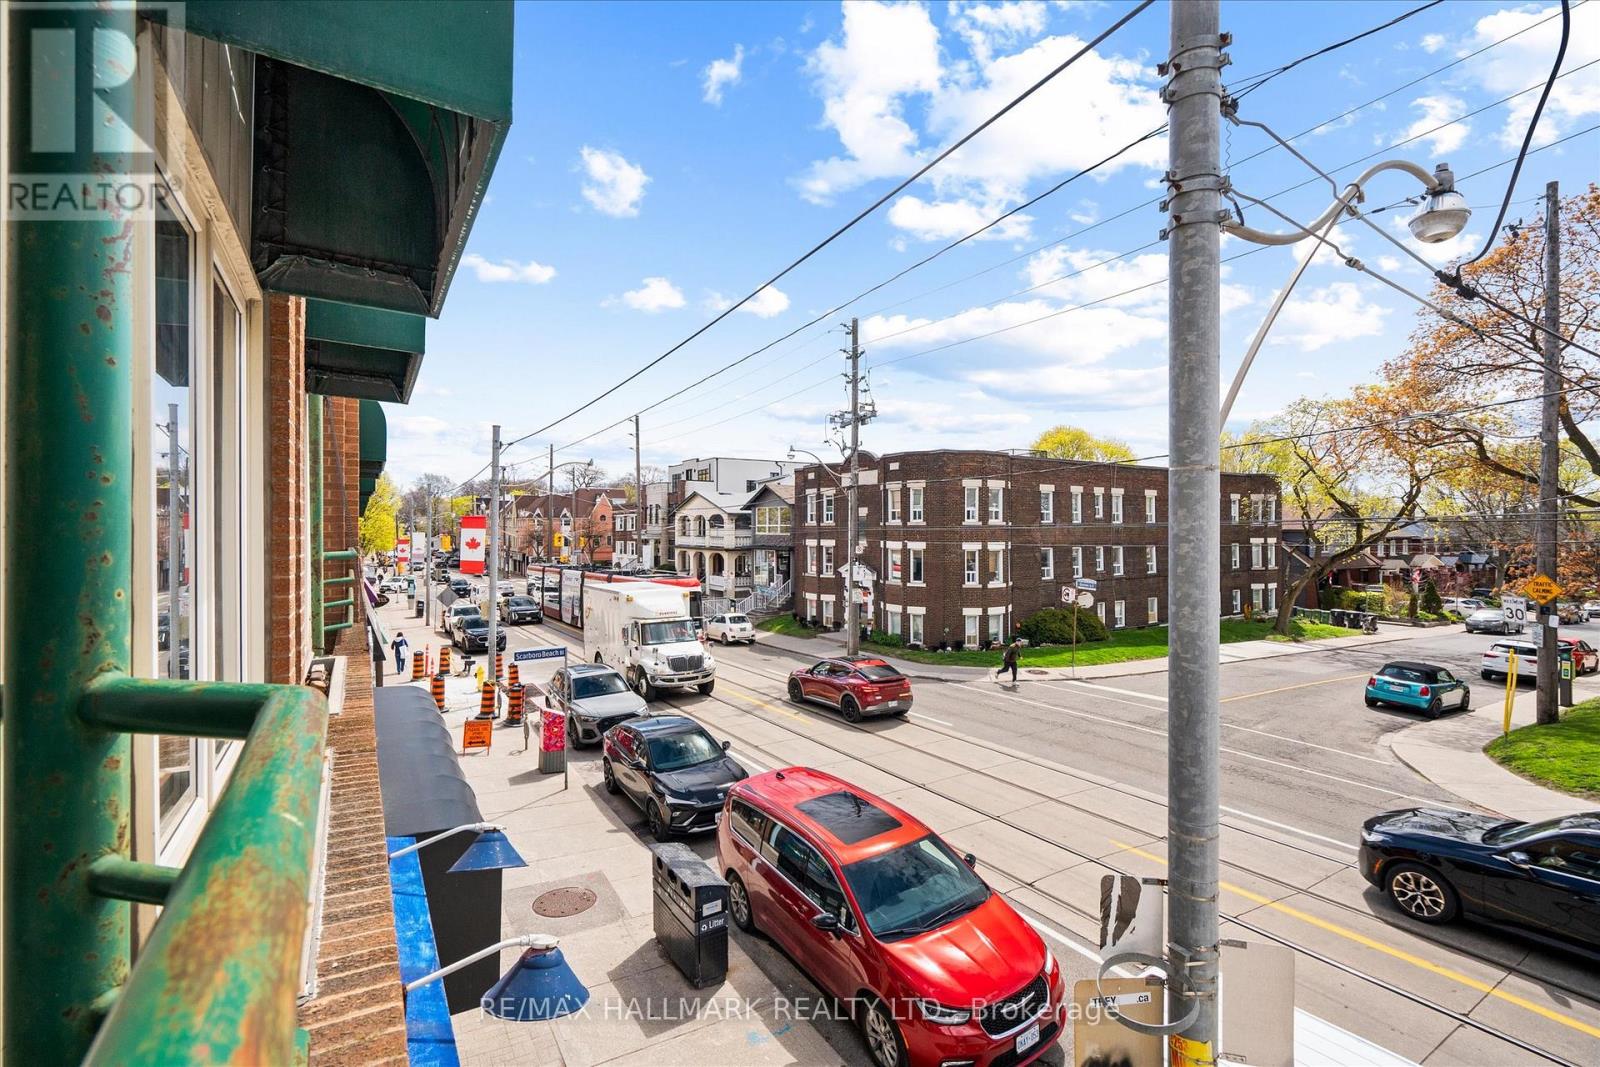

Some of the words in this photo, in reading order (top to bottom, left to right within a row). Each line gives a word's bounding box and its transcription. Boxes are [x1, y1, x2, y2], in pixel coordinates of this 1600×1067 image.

[1505, 606, 1524, 621] 30
[515, 651, 542, 660] Scarboro
[542, 649, 559, 658] Beach
[708, 918, 725, 929] Litter
